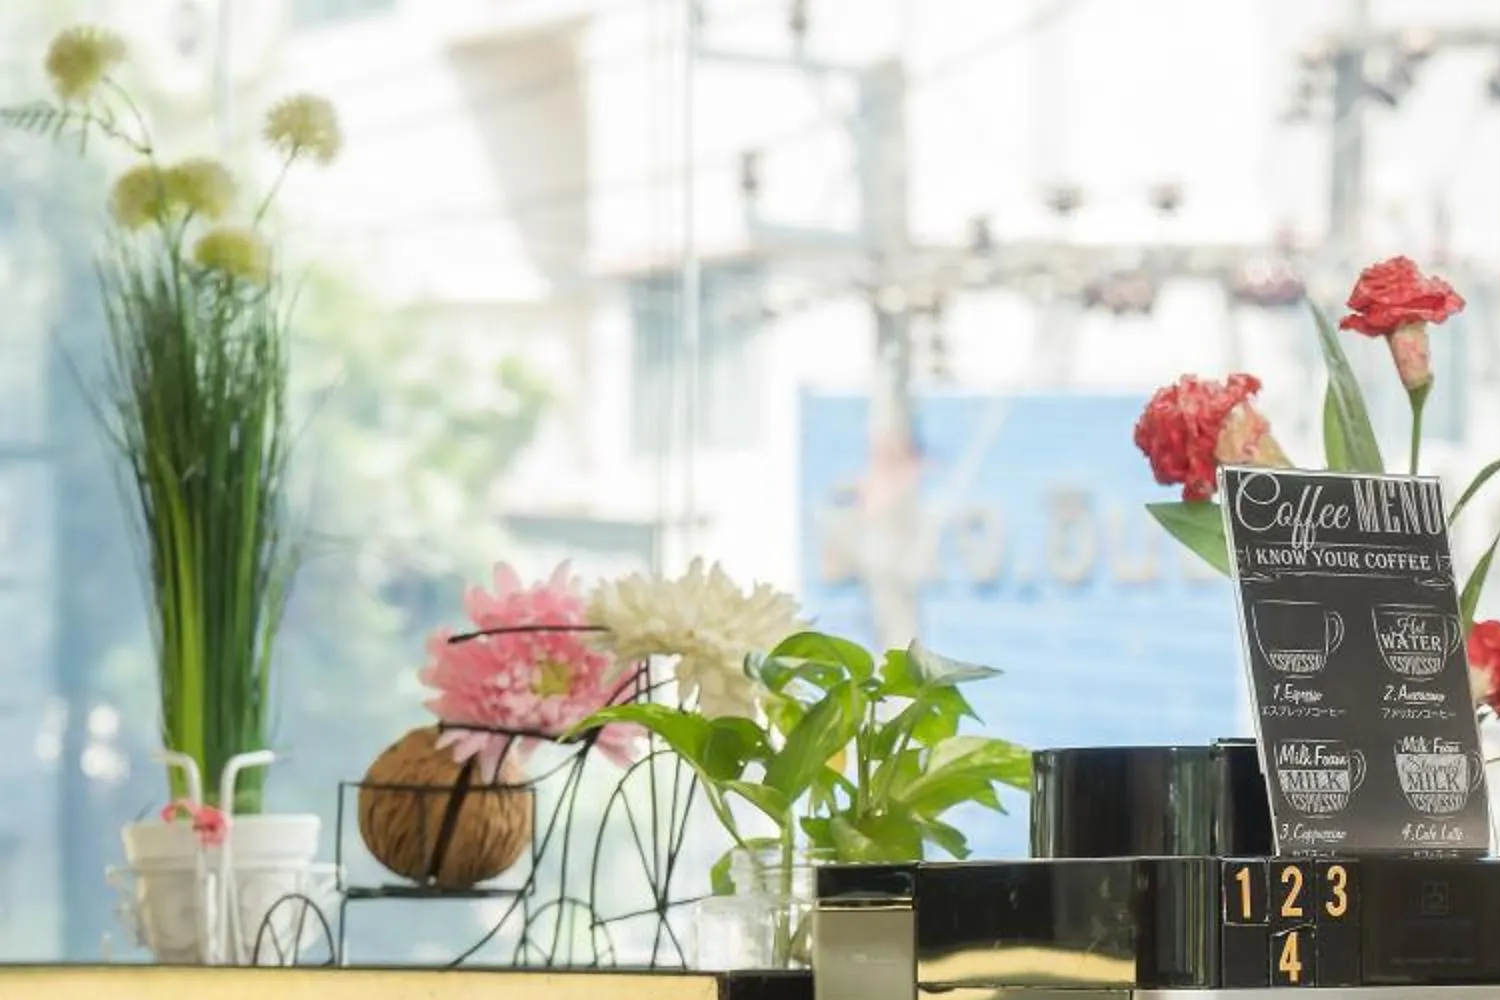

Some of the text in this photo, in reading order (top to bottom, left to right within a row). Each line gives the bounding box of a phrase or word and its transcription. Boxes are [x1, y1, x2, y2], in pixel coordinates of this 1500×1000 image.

[1236, 471, 1351, 551] Coffee
[1352, 480, 1441, 535] MENU
[1256, 548, 1432, 571] KNOW YOUR COFFEE
[1381, 632, 1443, 651] WATER
[1280, 743, 1312, 765] Milk
[1286, 772, 1342, 790] MILK
[1407, 770, 1460, 791] MILK
[1235, 865, 1347, 919] 1 2 3
[1279, 931, 1302, 982] 4
